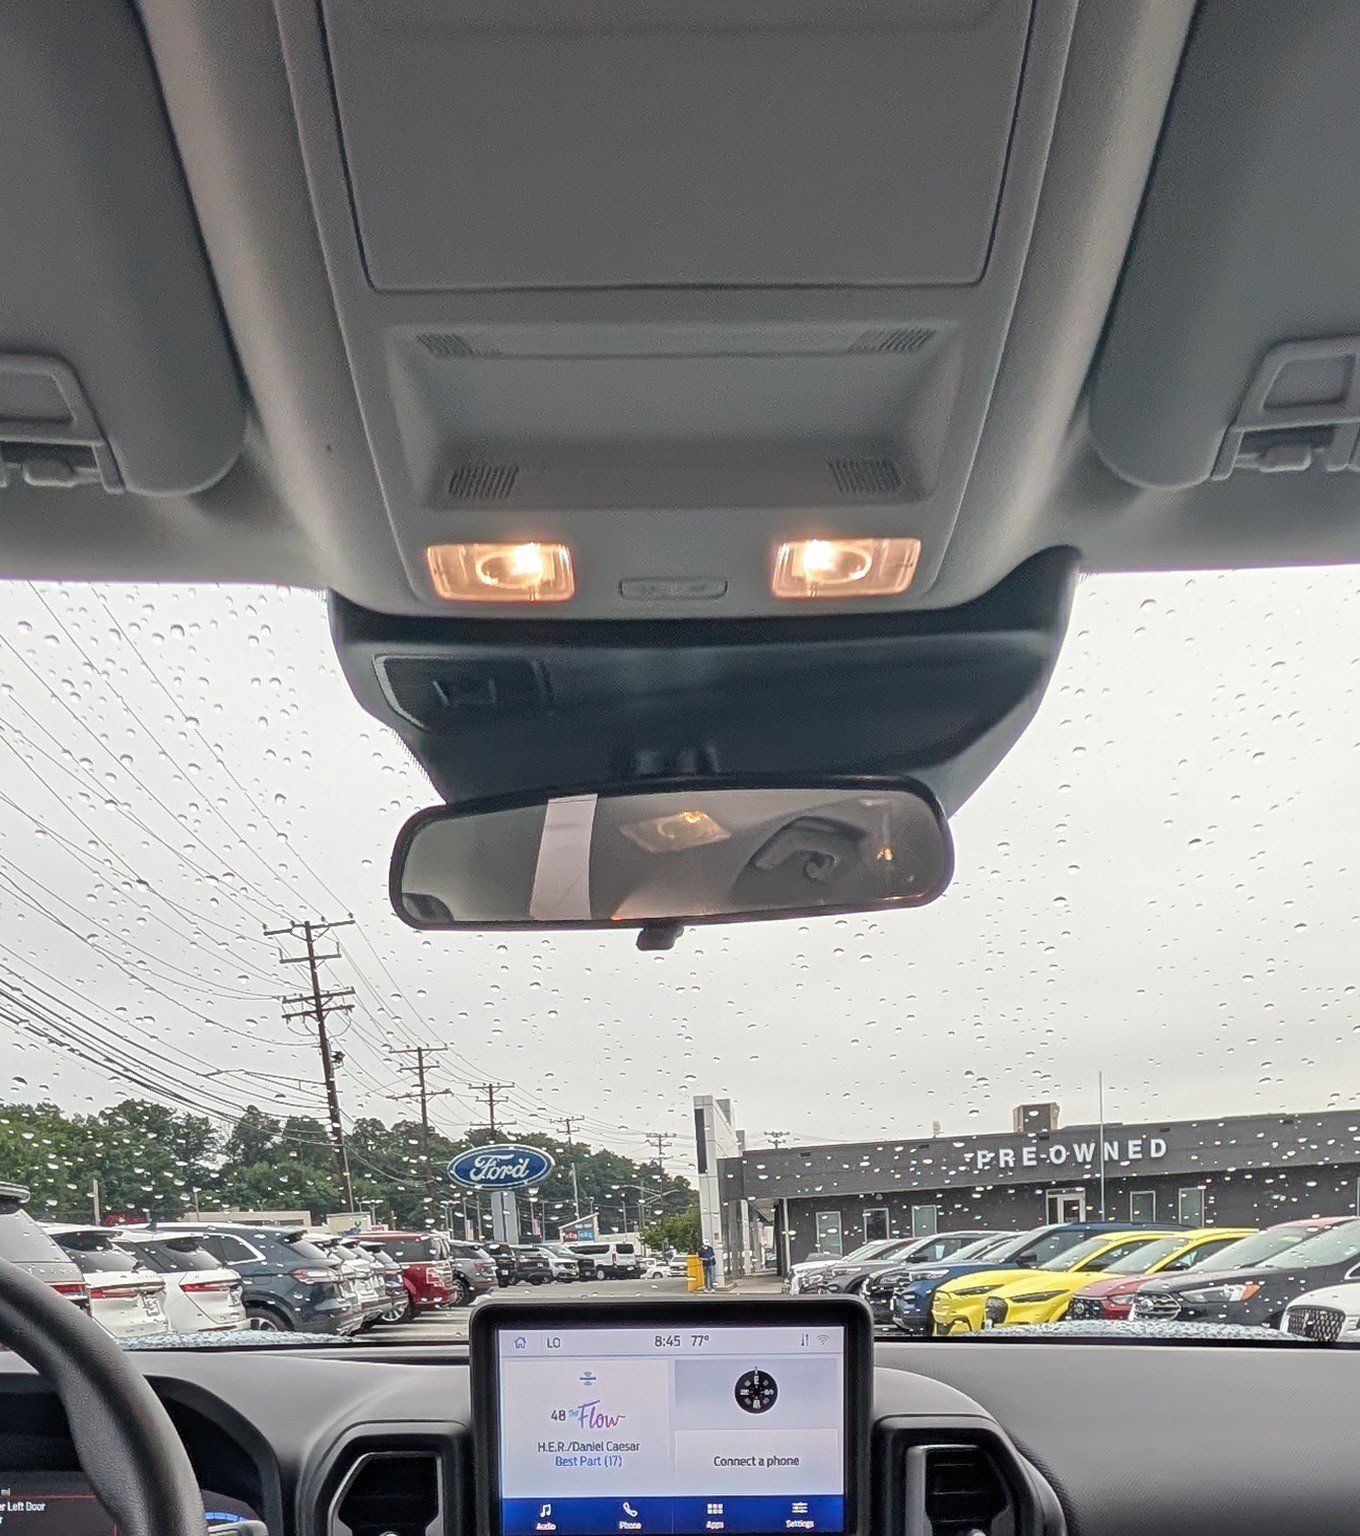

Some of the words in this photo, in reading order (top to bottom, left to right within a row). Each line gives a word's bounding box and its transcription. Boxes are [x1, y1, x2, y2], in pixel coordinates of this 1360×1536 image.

[977, 1138, 1167, 1169] PRE-OWNED
[470, 1153, 529, 1181] Ford
[547, 1337, 561, 1349] LO
[654, 1335, 681, 1347] 8:45
[690, 1334, 710, 1347] 77°
[551, 1409, 566, 1421] 48
[577, 1399, 626, 1429] Flow
[606, 1441, 640, 1452] Caesar
[555, 1456, 578, 1467] Best
[580, 1456, 601, 1467] Part
[604, 1455, 622, 1468] (17)
[713, 1455, 756, 1467] Connect
[758, 1458, 765, 1466] a
[767, 1455, 800, 1468] phone
[7, 1502, 24, 1511] Left
[26, 1502, 45, 1511] Door
